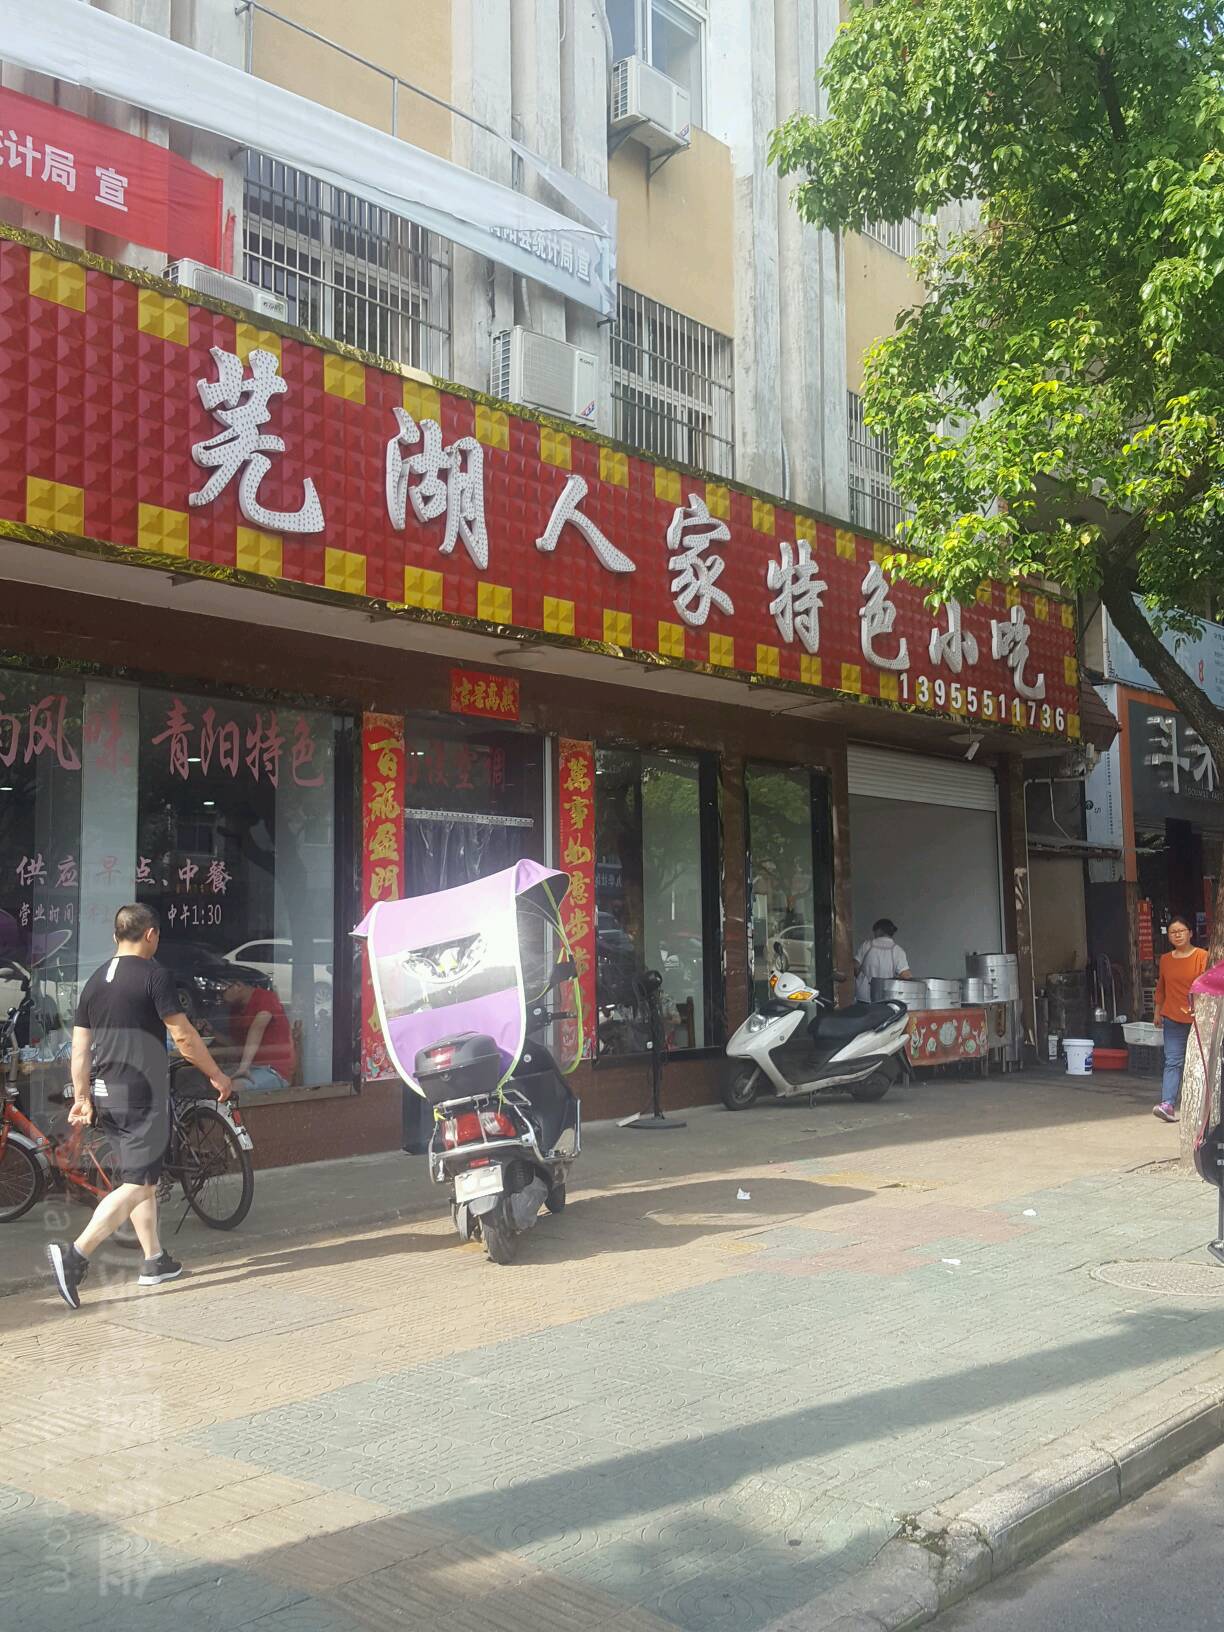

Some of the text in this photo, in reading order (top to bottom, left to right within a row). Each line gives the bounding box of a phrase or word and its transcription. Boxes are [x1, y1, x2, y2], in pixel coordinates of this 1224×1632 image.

[0, 130, 128, 212] 计局 宣
[189, 345, 1046, 700] 芜湖人家特色小吃
[152, 696, 325, 788] 青阳特色
[900, 672, 1065, 732] 13955511736
[18, 902, 75, 927] 营业时间
[167, 903, 223, 929] 中午1:30
